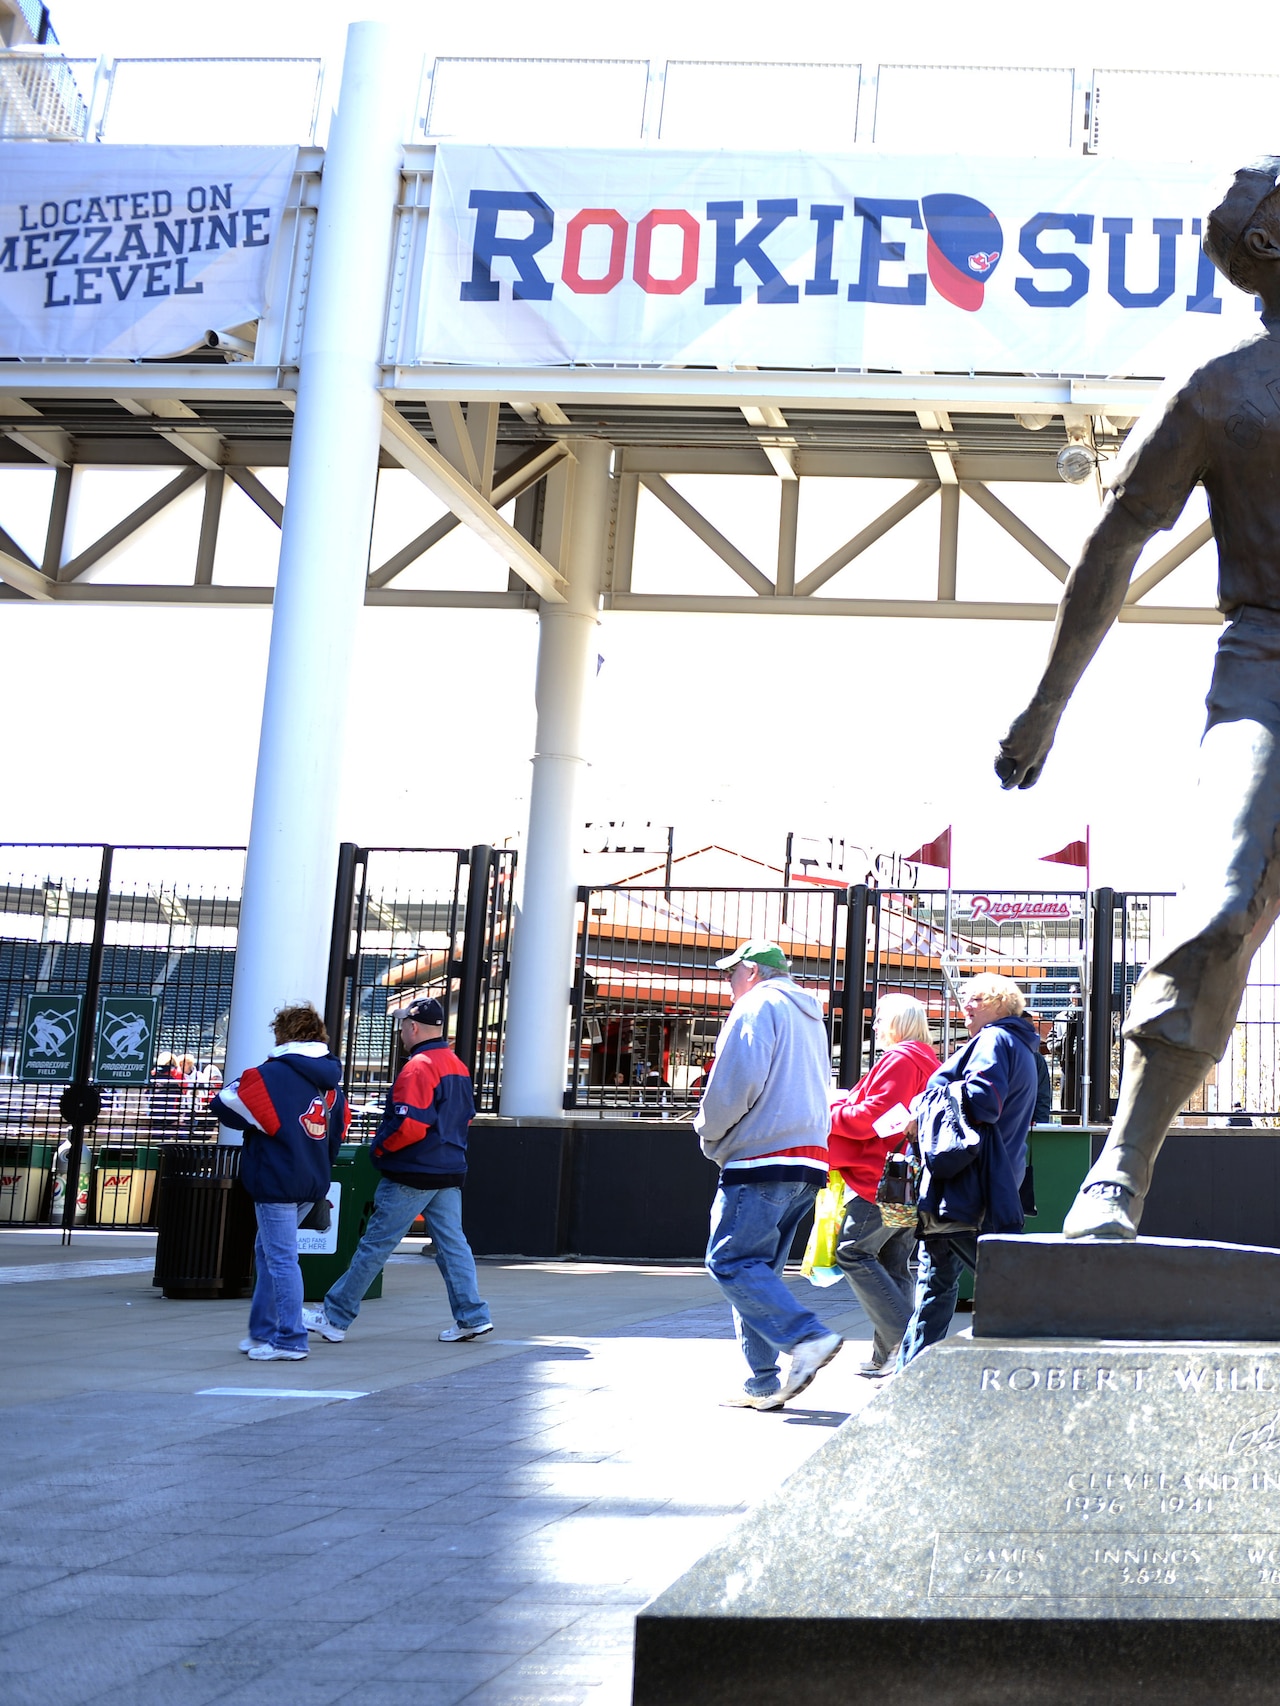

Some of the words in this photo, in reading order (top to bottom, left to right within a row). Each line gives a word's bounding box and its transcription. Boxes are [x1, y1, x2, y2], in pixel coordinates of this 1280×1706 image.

[19, 189, 172, 231] LOCATED
[187, 183, 232, 213] ON
[460, 190, 928, 305] ROOKIE
[44, 257, 203, 308] LEVEL
[969, 895, 1070, 919] Programs
[25, 1061, 71, 1069] PROGRESSIVE
[100, 1063, 146, 1071] PROGRESSIVE
[980, 1366, 1153, 1392] ROBERT
[1066, 1472, 1240, 1492] CLEVELAND
